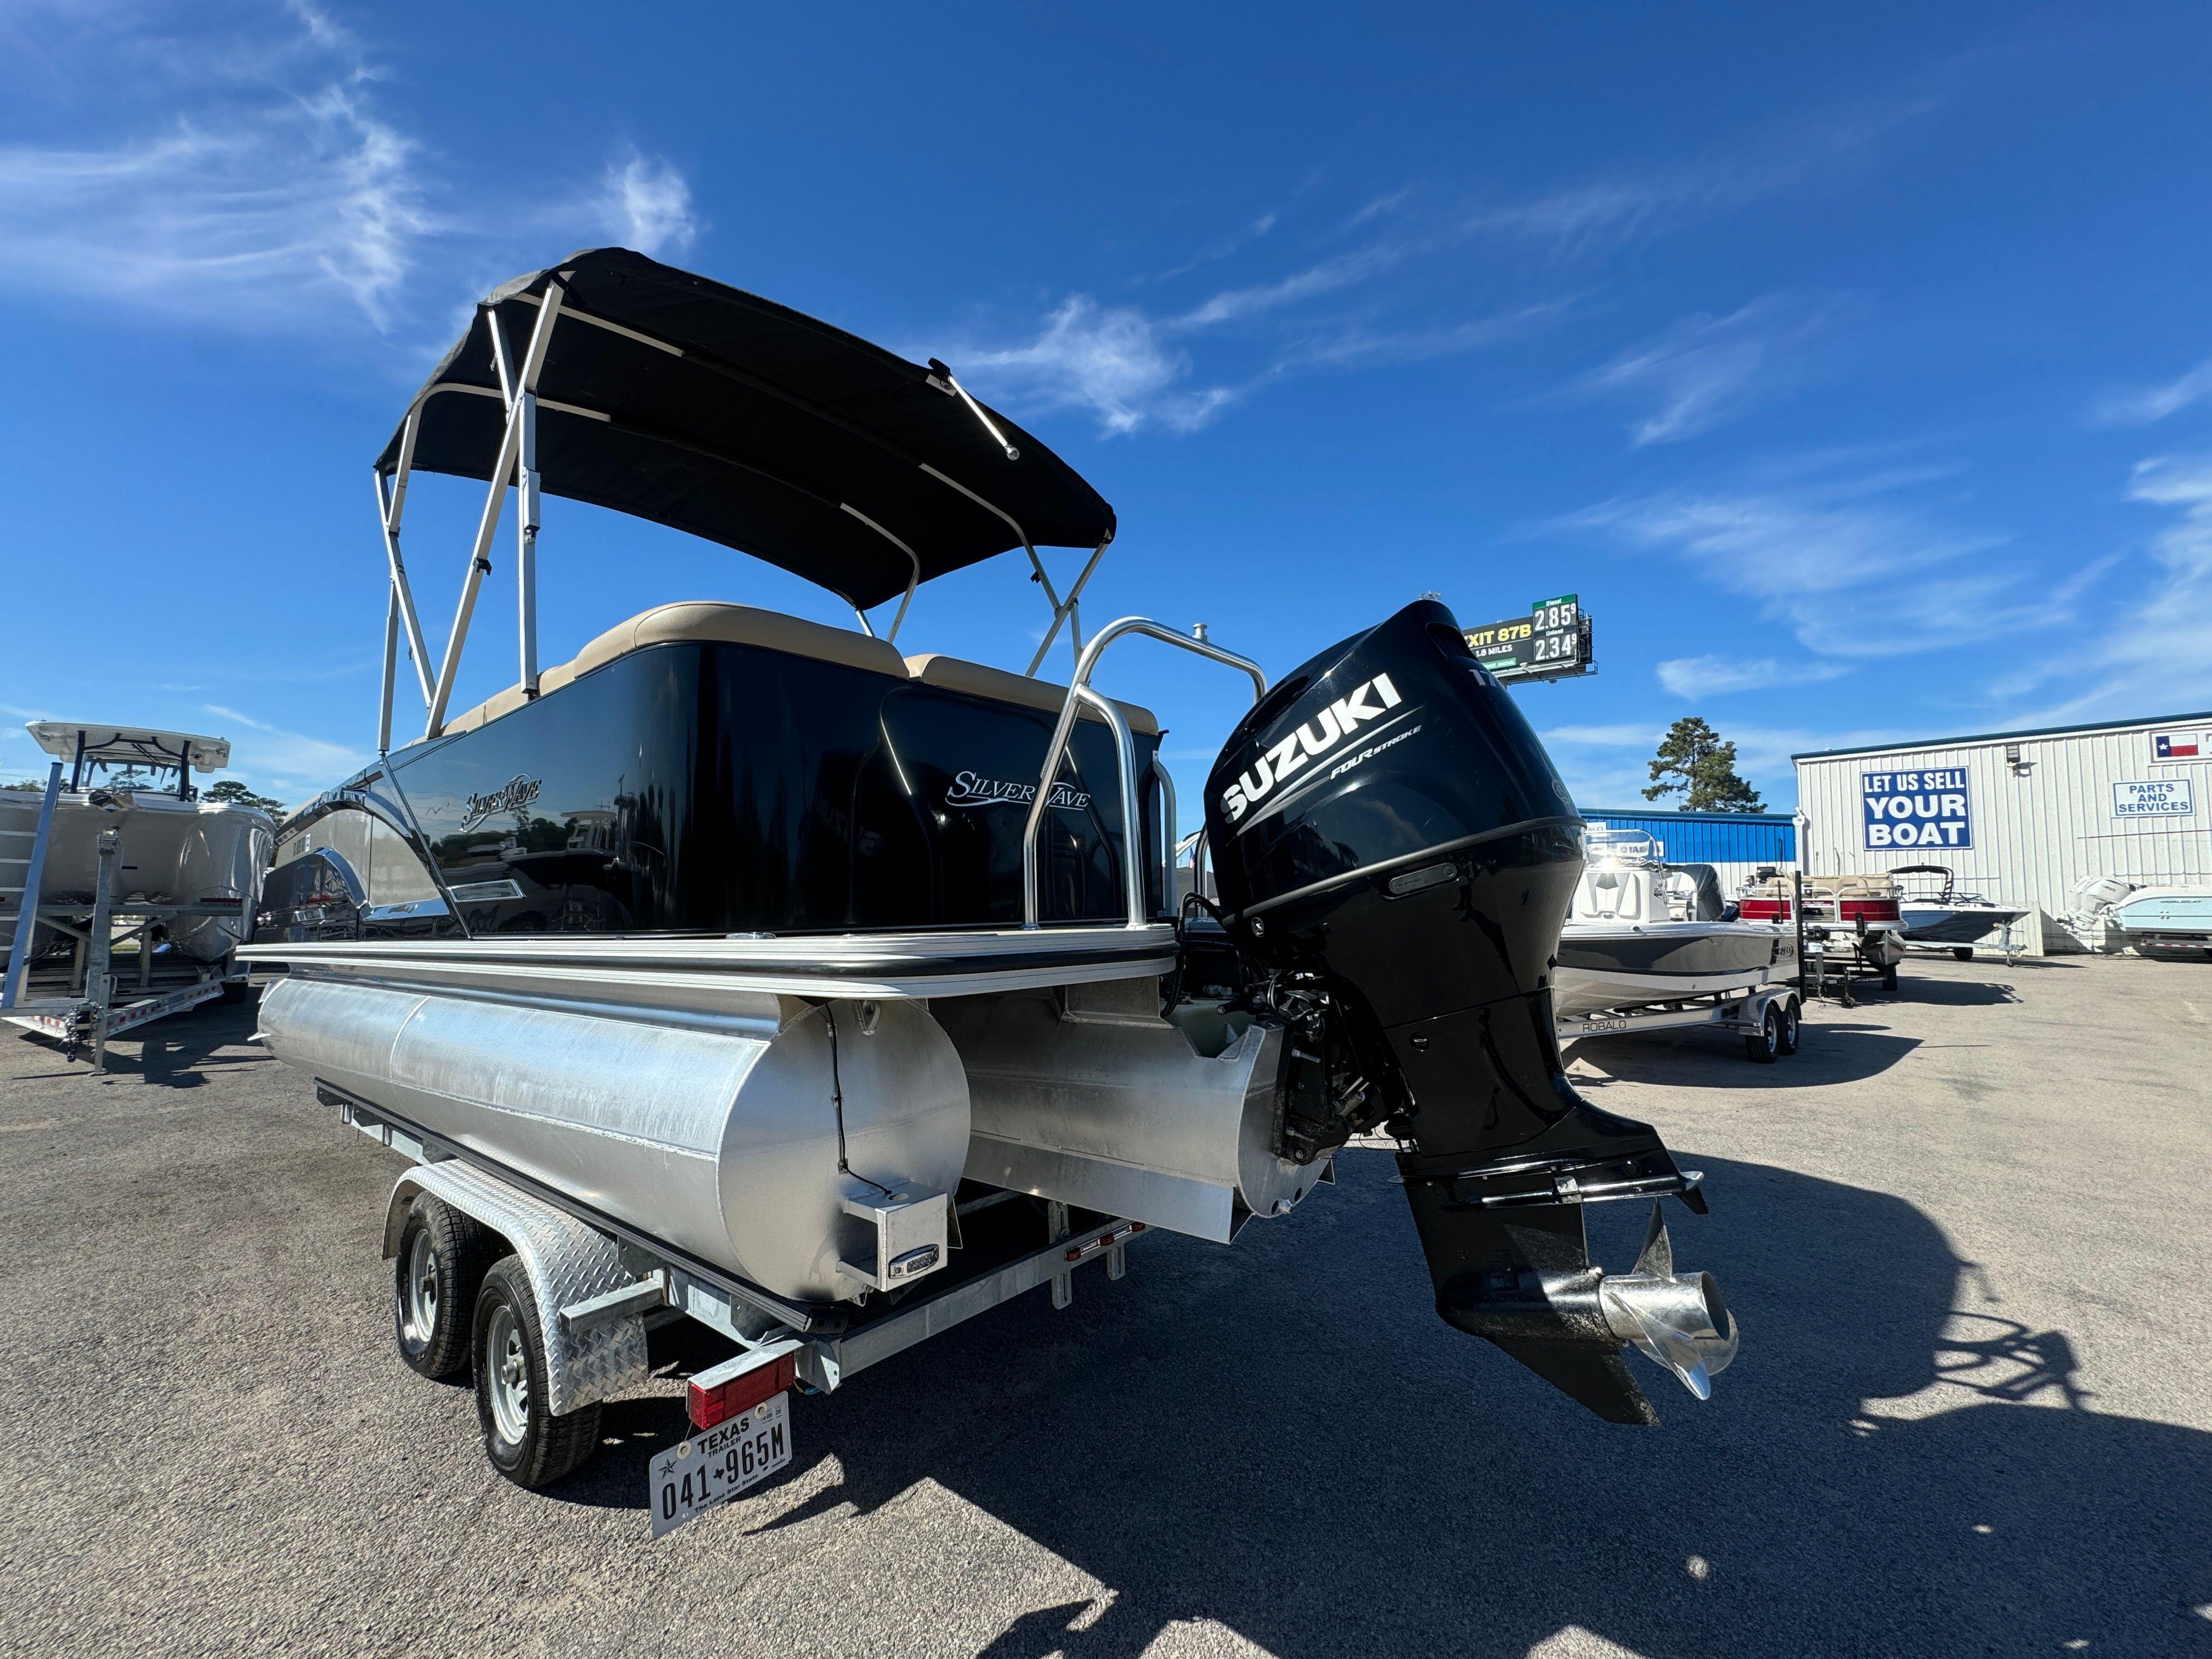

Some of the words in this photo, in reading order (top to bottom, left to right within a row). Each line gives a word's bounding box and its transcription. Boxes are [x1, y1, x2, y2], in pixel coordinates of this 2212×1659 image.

[1498, 624, 1531, 642] 87B
[1488, 645, 1513, 655] MILES
[1221, 673, 1402, 823] SUZUKI
[1864, 775, 1892, 793] LET
[1896, 774, 1918, 791] US
[1923, 771, 1965, 790] SELL
[2129, 783, 2174, 794] PARTS
[1865, 794, 1966, 819] YOUR
[2119, 802, 2188, 812] SERVICES
[2138, 793, 2167, 802] AND
[1868, 822, 1965, 845] BOAT
[1583, 1020, 1627, 1032] ROBALO
[698, 1417, 749, 1453] TEXAS
[708, 1436, 741, 1458] TRAILER
[726, 1423, 783, 1483] 965M
[695, 1503, 707, 1513] The
[710, 1493, 725, 1504] Lone
[727, 1484, 741, 1495] Star
[742, 1475, 758, 1486] State
